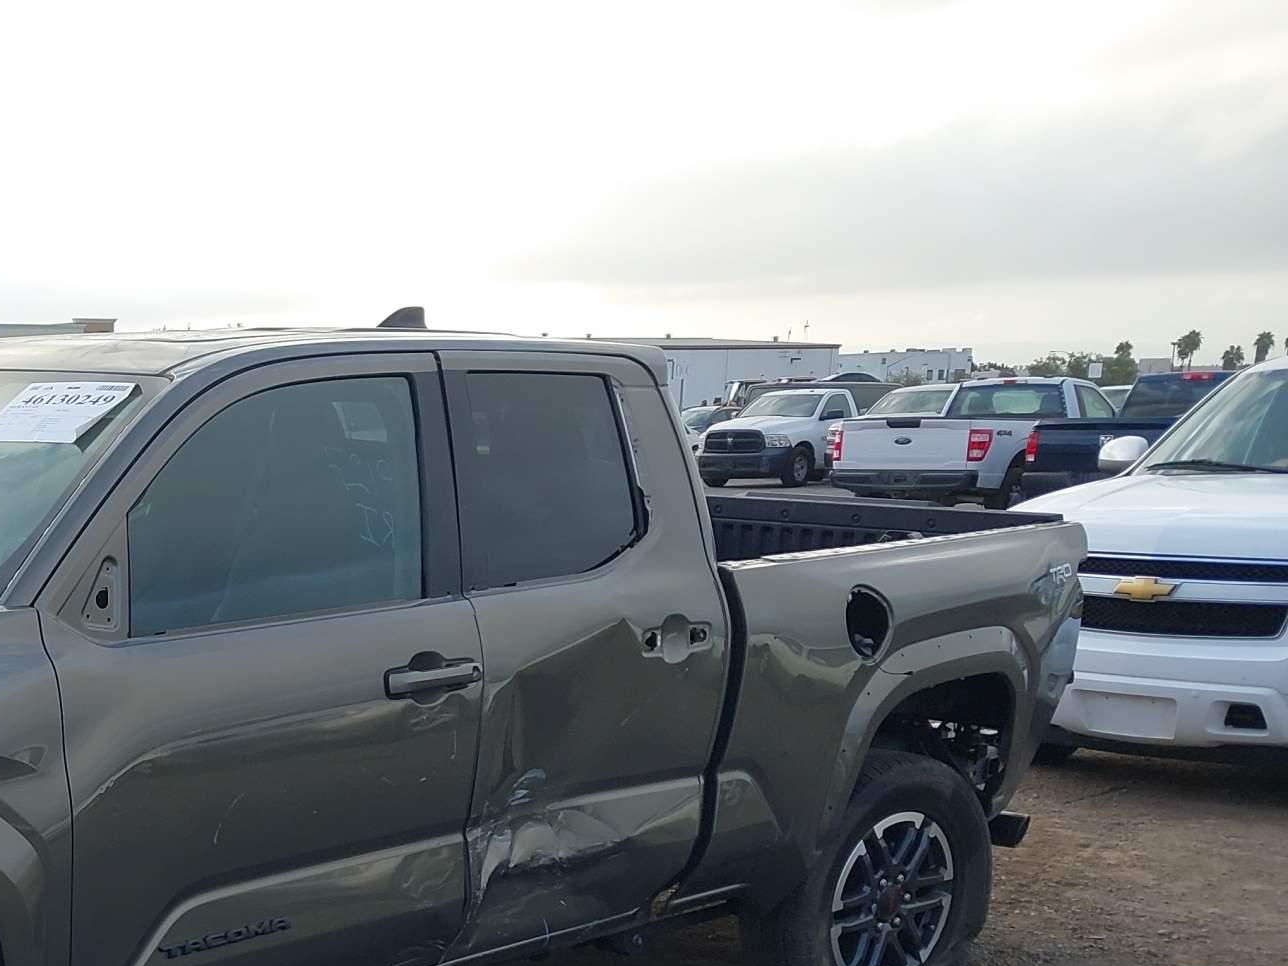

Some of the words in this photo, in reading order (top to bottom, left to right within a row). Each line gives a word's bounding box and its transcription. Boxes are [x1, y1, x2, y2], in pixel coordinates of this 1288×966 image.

[22, 393, 116, 406] 46130249
[1050, 562, 1072, 584] TRD
[158, 916, 292, 959] TACOMA
